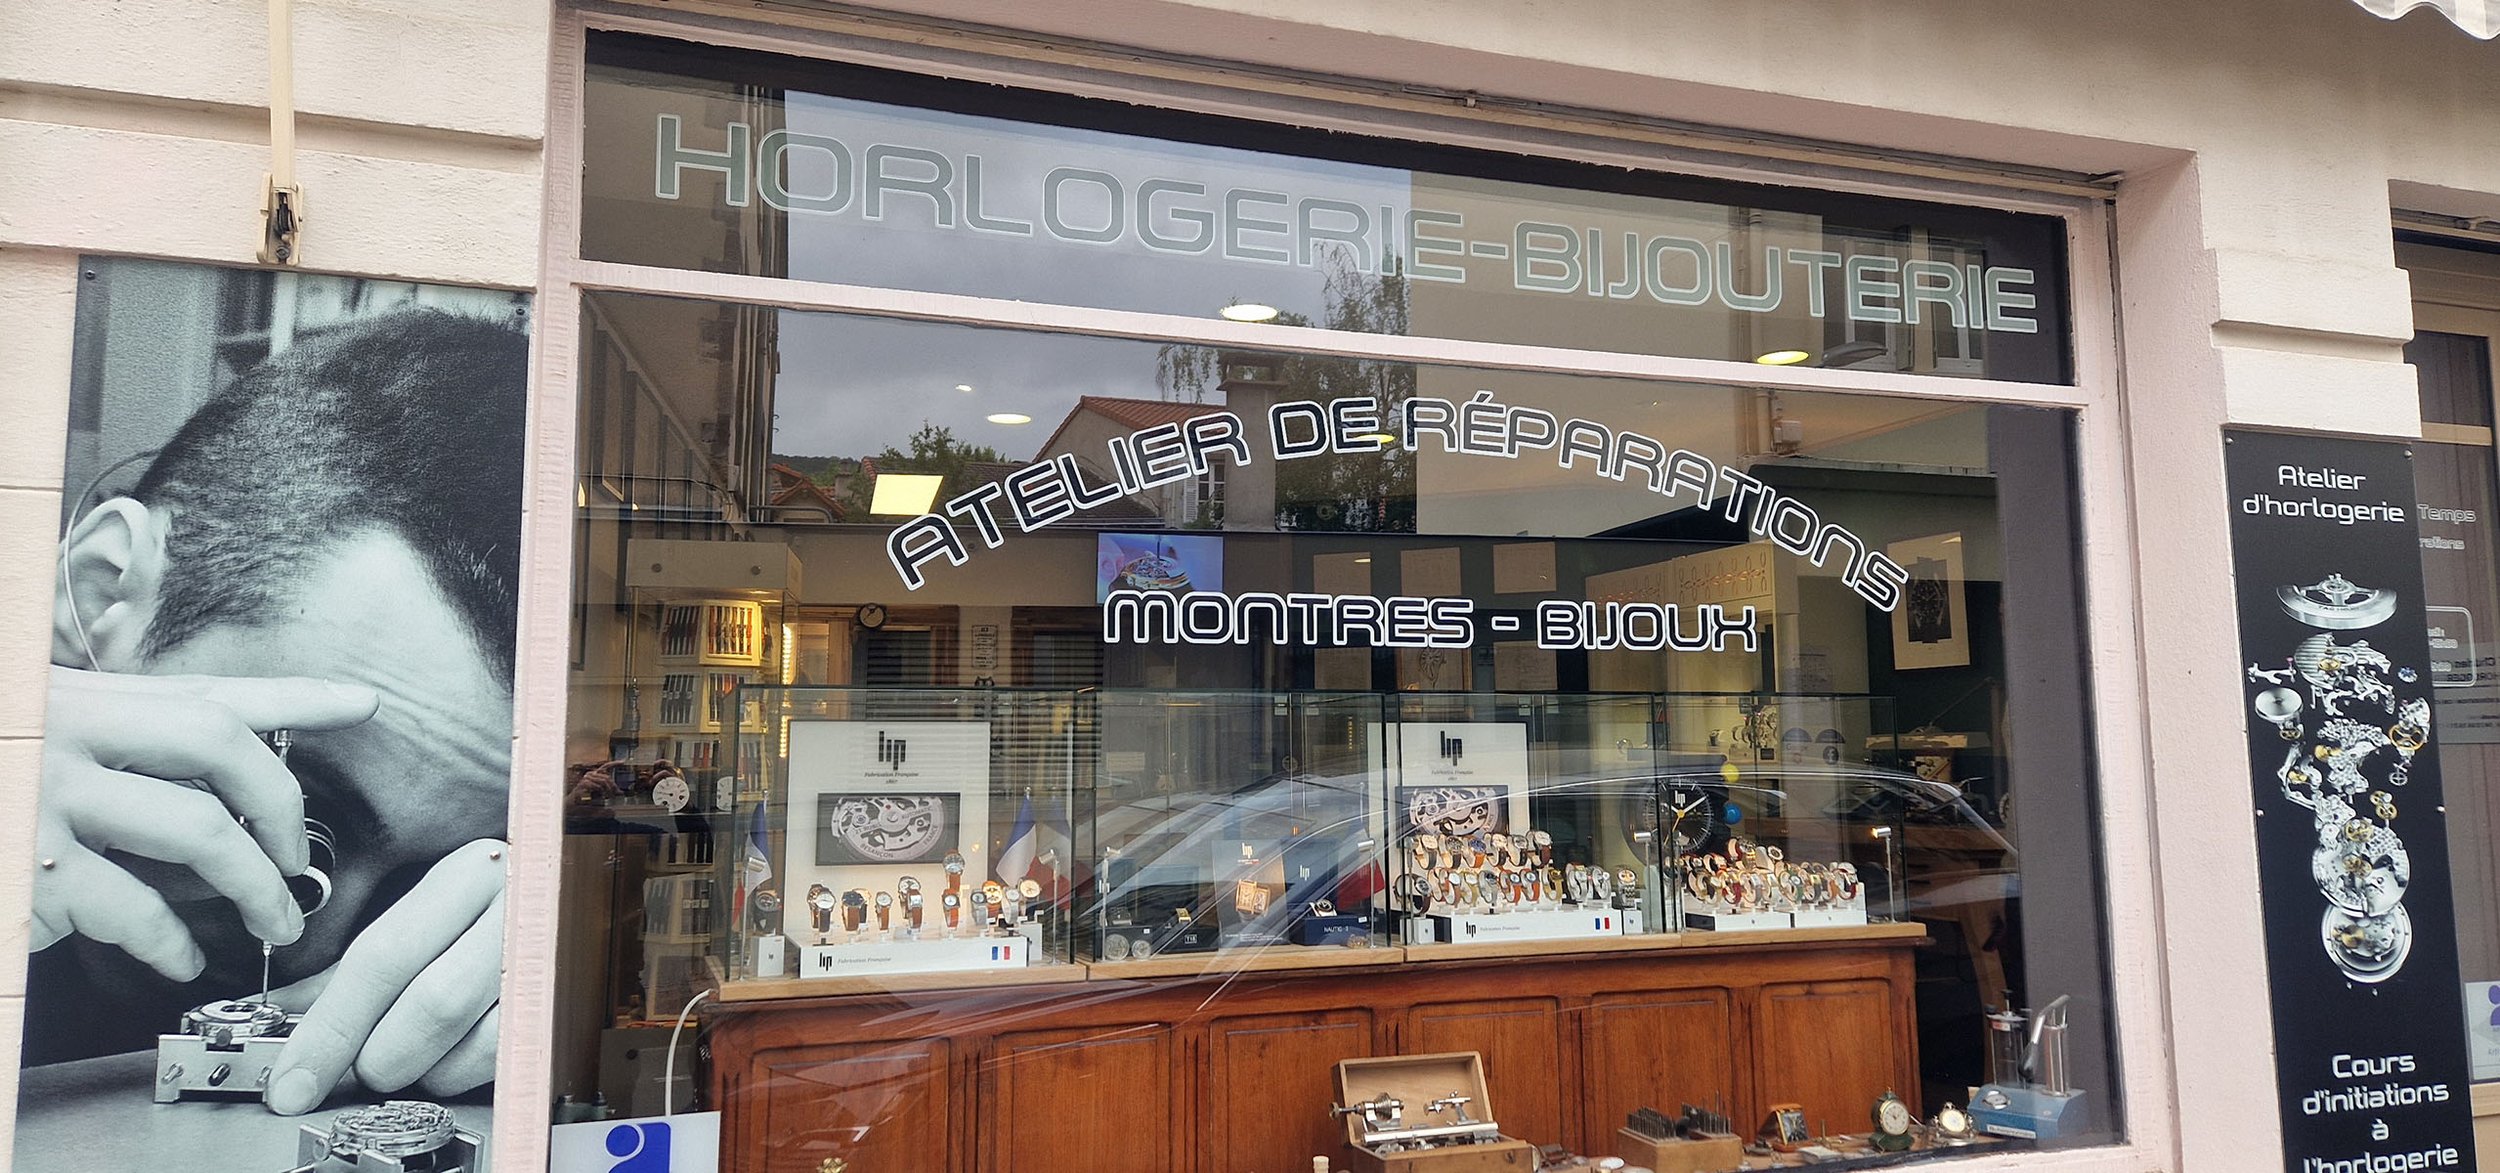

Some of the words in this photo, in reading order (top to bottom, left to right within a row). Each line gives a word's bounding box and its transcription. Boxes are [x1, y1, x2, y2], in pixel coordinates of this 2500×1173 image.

[655, 113, 2038, 333] HORLOGERIE-BIJOUTERIE
[2277, 464, 2367, 490] Atelier
[886, 411, 1251, 590] ATELIER
[1267, 397, 1383, 461] DE
[1402, 390, 1909, 613] RÉPARATIONS
[2242, 493, 2405, 525] d'horlogerie
[2417, 503, 2477, 525] Temps
[1103, 589, 1475, 648] MONTRES
[1537, 599, 1757, 653] BIJOUX
[878, 731, 906, 771] lip
[1440, 730, 1463, 766] lip
[1674, 790, 1686, 808] lip
[1299, 864, 1310, 881] lip
[1465, 921, 1477, 938] lip
[819, 952, 833, 972] lip
[2332, 1053, 2416, 1079] Cours
[2302, 1081, 2450, 1115] d'initiations
[2371, 1117, 2390, 1141] à
[2303, 1143, 2460, 1173] l'horlogerie
